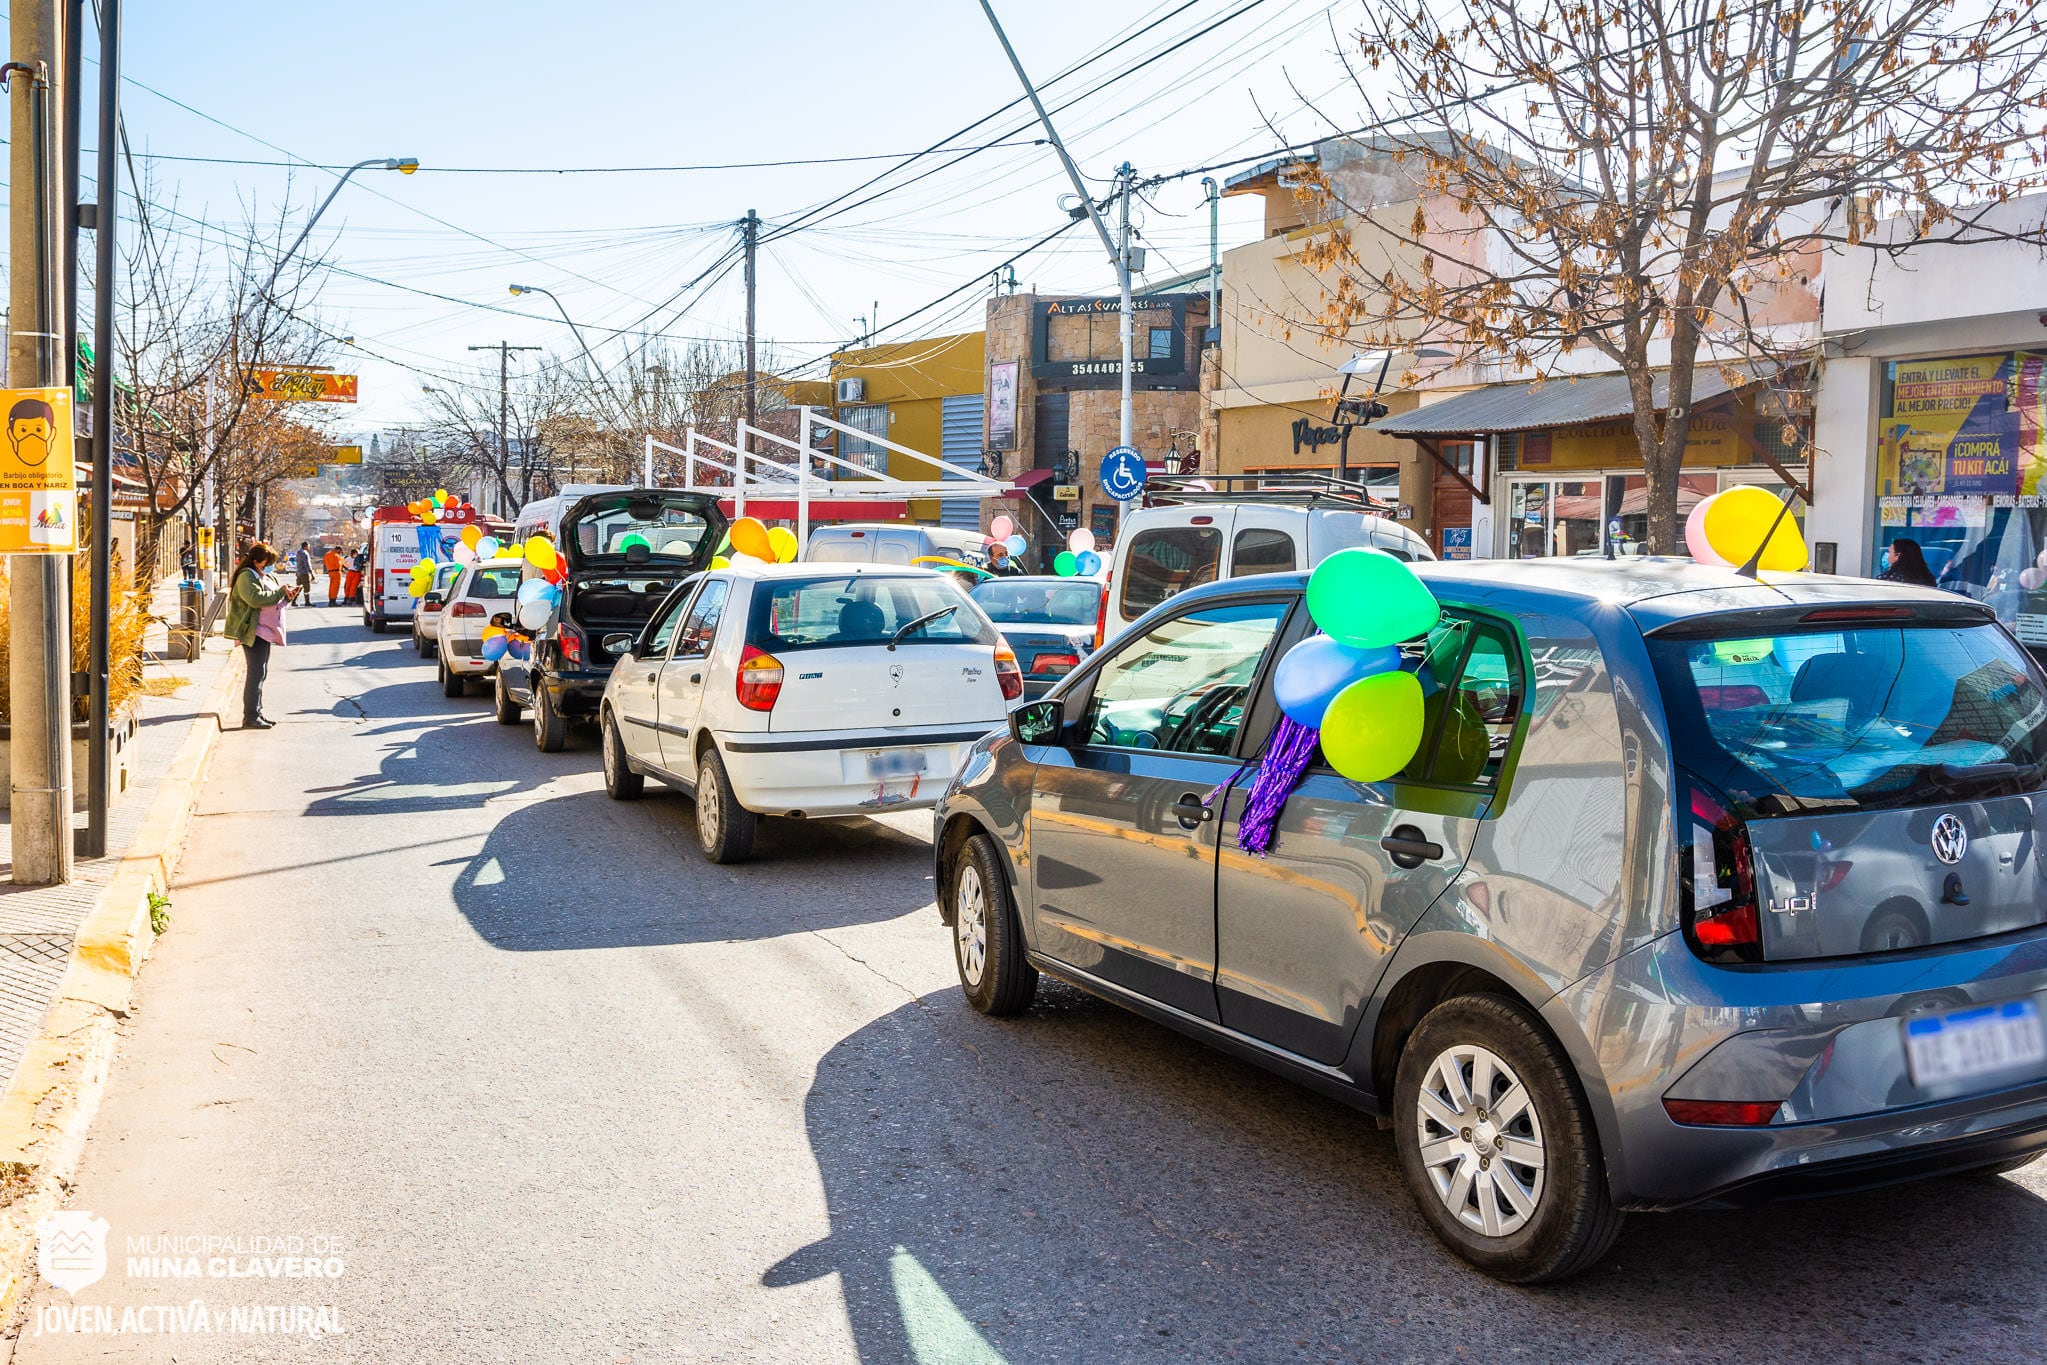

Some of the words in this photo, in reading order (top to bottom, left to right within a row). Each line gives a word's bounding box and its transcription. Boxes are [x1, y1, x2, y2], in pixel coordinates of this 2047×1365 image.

[1094, 299, 1148, 312] CUMRES
[1072, 361, 1144, 375] 354440355
[1935, 368, 1970, 382] LLEVATE
[1971, 367, 1981, 379] EL
[1897, 384, 1925, 399] MEJOR
[1926, 380, 2003, 397] ENTRETENIMIENTO
[1897, 401, 1907, 413] AL
[1908, 399, 1937, 412] MEJOR
[1938, 397, 1971, 410] PRECIO!
[1108, 448, 1142, 462] RESERVADO
[1954, 438, 2001, 457] ¡COMPRÁ
[1953, 460, 1966, 475] TU
[1967, 459, 1983, 475] KIT
[1984, 457, 2009, 475] ACÁ!
[3, 472, 27, 480] Barbijo
[28, 472, 63, 480] obligatorio
[1102, 478, 1143, 499] DISCAPACITADOS
[391, 534, 402, 543] 110
